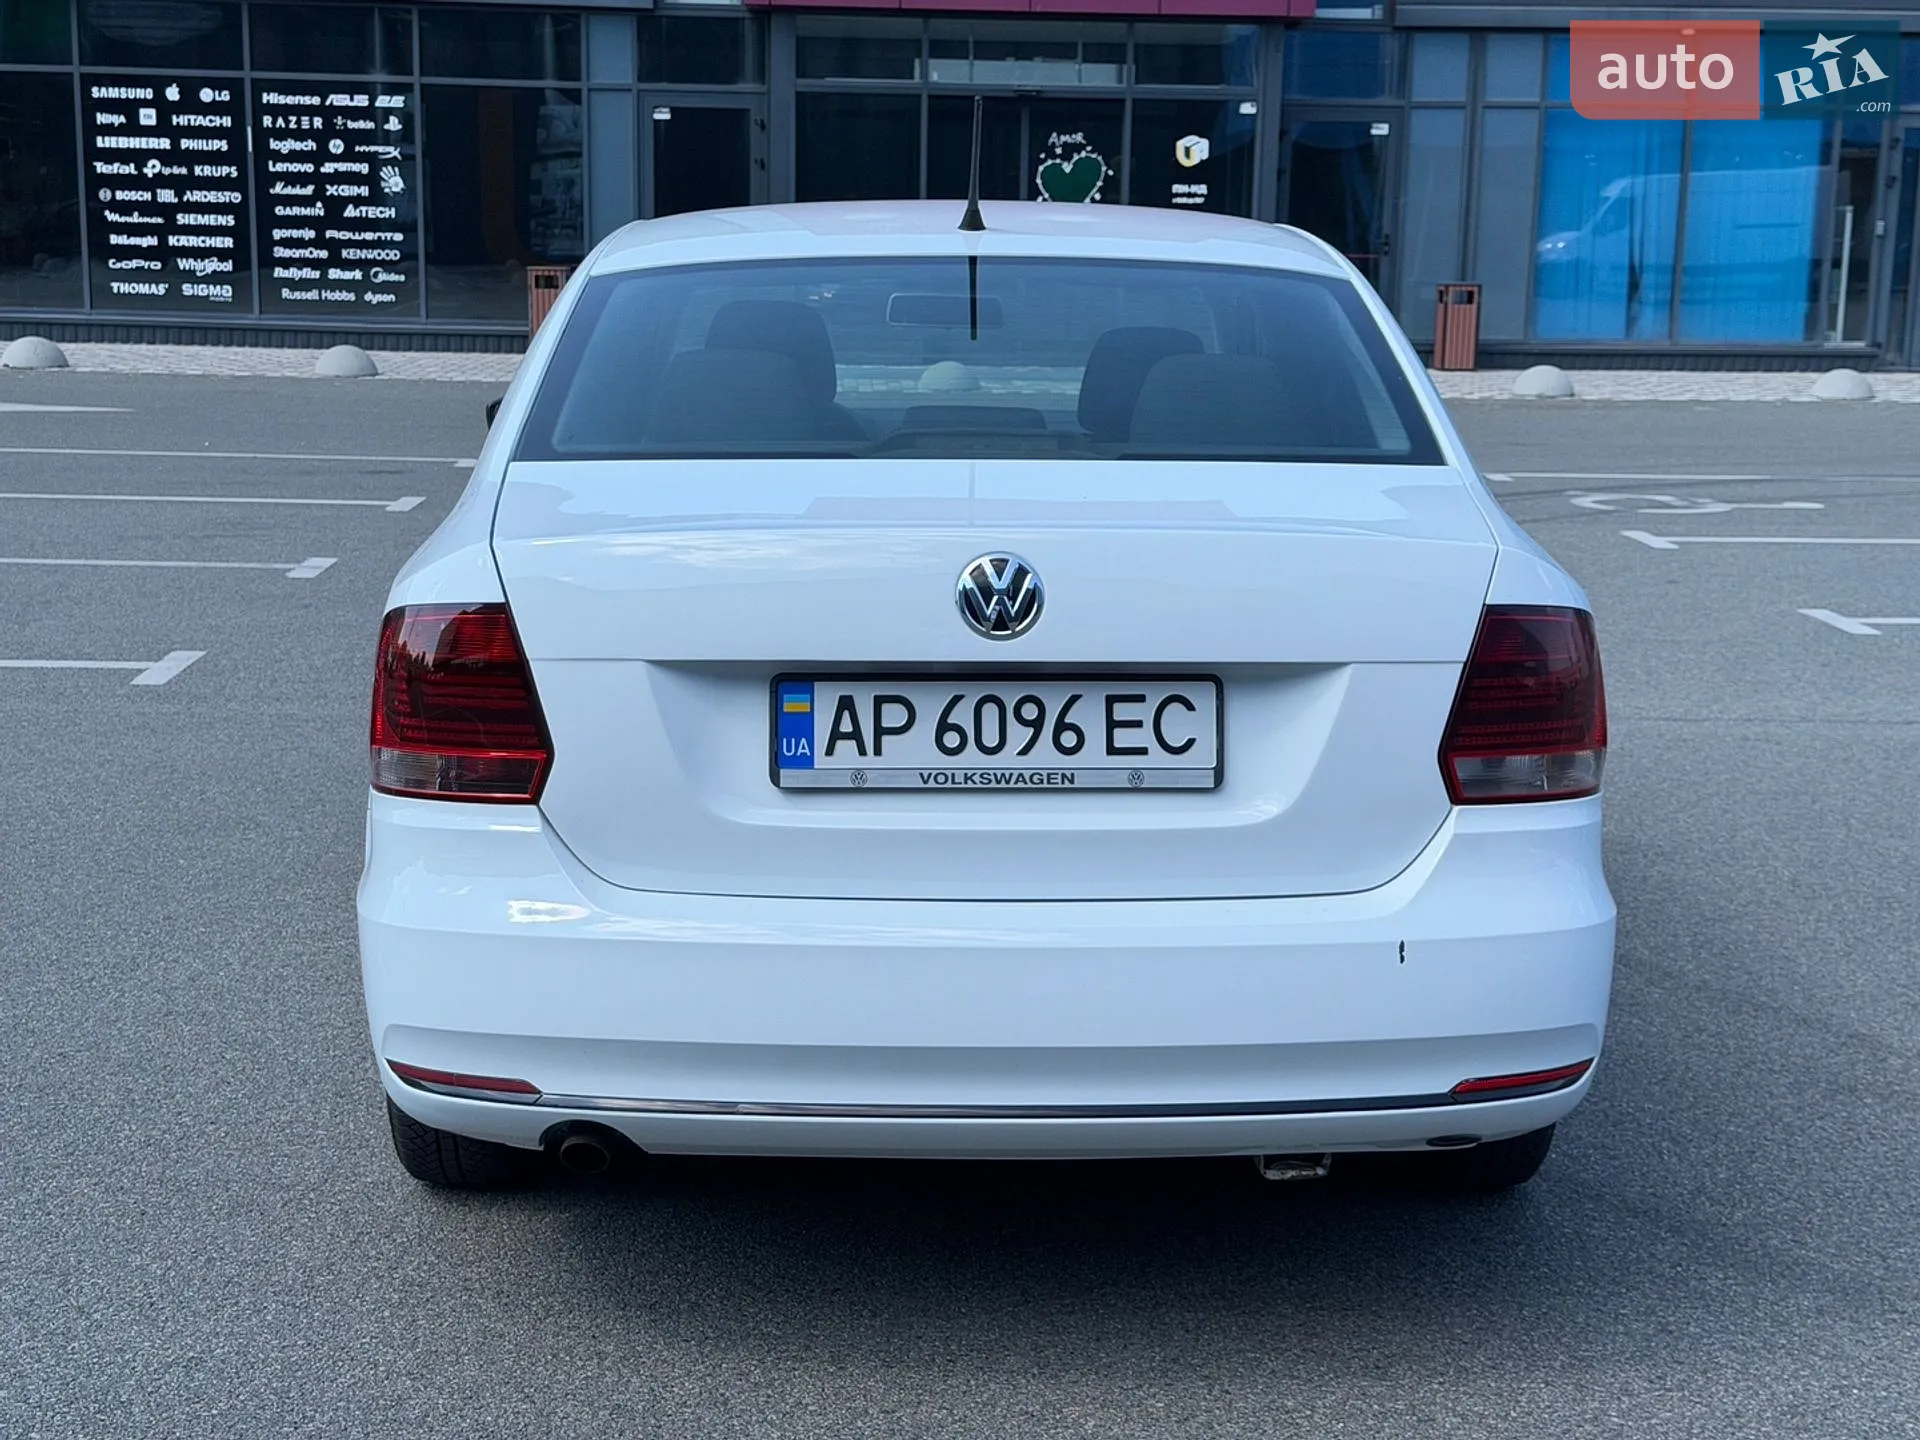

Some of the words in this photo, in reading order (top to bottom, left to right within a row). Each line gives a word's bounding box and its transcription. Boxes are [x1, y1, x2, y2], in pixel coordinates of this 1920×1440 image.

[91, 86, 154, 100] SAMSUNG
[261, 92, 322, 106] Hisense
[325, 94, 370, 107] ASUS
[171, 114, 232, 128] HITACHI
[262, 115, 323, 130] RAZER
[95, 136, 172, 150] LIEBHERR
[180, 138, 229, 152] PHILIPS
[269, 138, 317, 154] logitech
[194, 165, 239, 178] KRUPS
[268, 160, 315, 174] Lenovo
[115, 190, 152, 201] BOSCH
[183, 190, 242, 204] ARDESTO
[325, 184, 370, 197] XGIMI
[274, 201, 325, 217] GARMIN
[176, 213, 236, 227] SIEMENS
[272, 227, 317, 241] gorenje
[273, 246, 330, 260] SteamOne
[341, 248, 401, 261] KENWOOD
[108, 258, 163, 271] GoPro
[176, 256, 234, 277] Whirlpool
[327, 267, 364, 281] Shark
[281, 288, 319, 301] Russell
[321, 289, 357, 302] Hobbs
[363, 290, 397, 305] dyson
[824, 694, 917, 757] AP
[934, 693, 1086, 757] 6096
[1104, 693, 1198, 756] EC
[783, 737, 811, 756] UA
[918, 772, 1076, 786] VOLKSWAGEN
